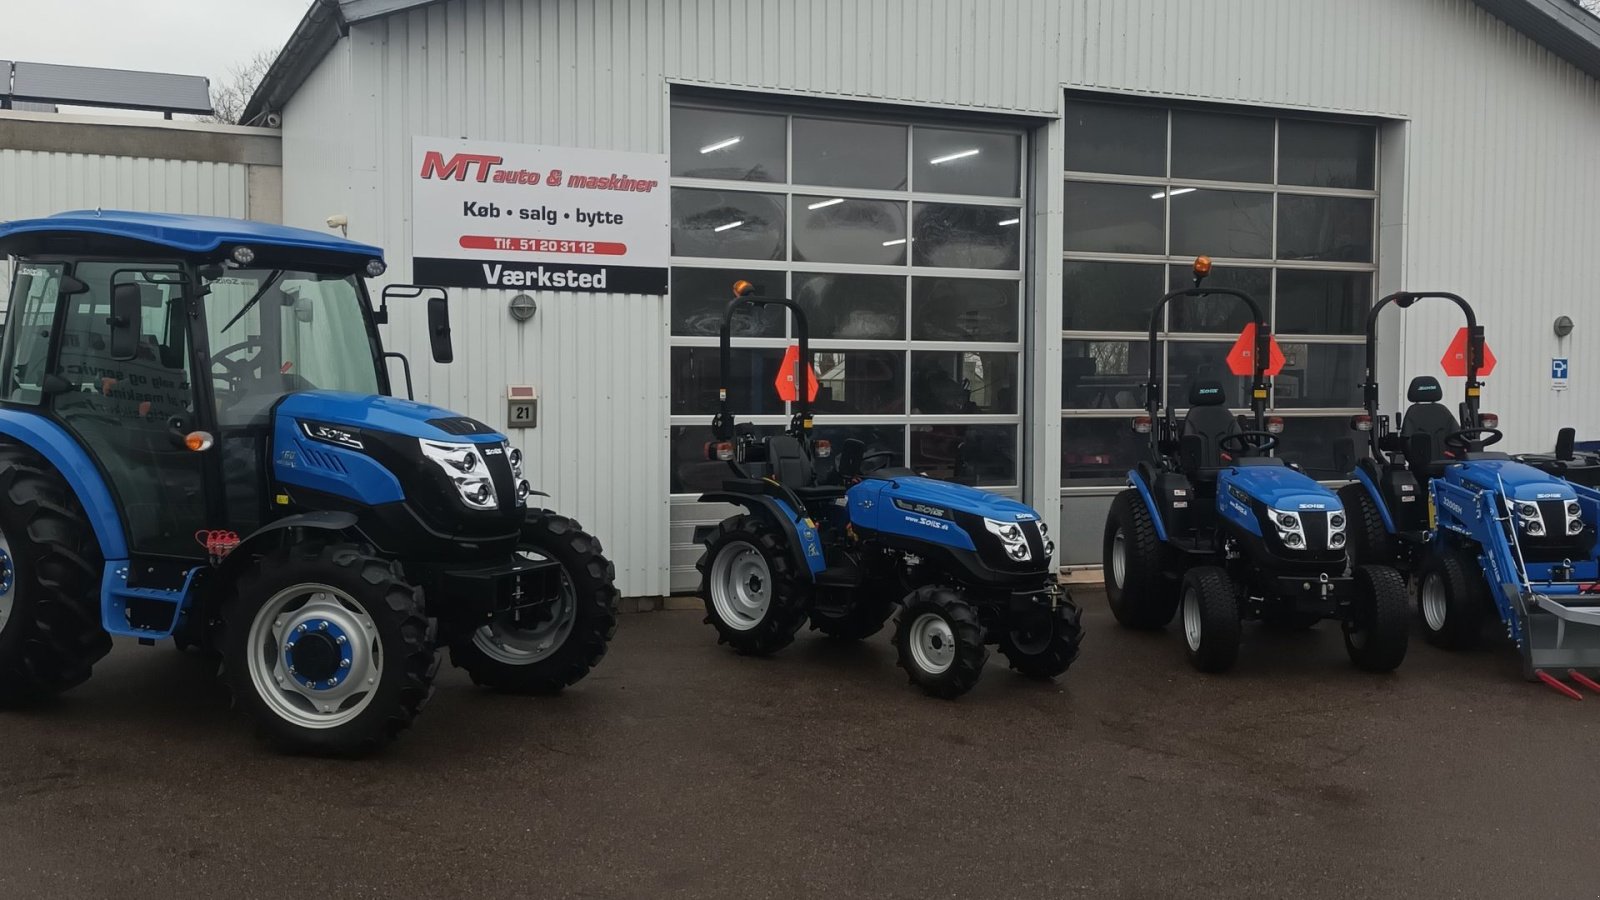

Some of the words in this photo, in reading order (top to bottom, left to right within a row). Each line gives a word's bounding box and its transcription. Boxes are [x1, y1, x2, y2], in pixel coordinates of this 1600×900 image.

[420, 151, 503, 183] MT
[492, 168, 540, 185] auto
[546, 169, 563, 187] &
[567, 173, 657, 193] maskiner
[463, 201, 501, 218] Køb
[519, 206, 557, 225] salg
[576, 208, 624, 227] bytte
[520, 239, 536, 251] 51
[540, 240, 557, 252] 20
[560, 241, 576, 253] 31
[578, 242, 595, 253] 12
[482, 263, 607, 289] Værksted
[516, 406, 530, 419] 21
